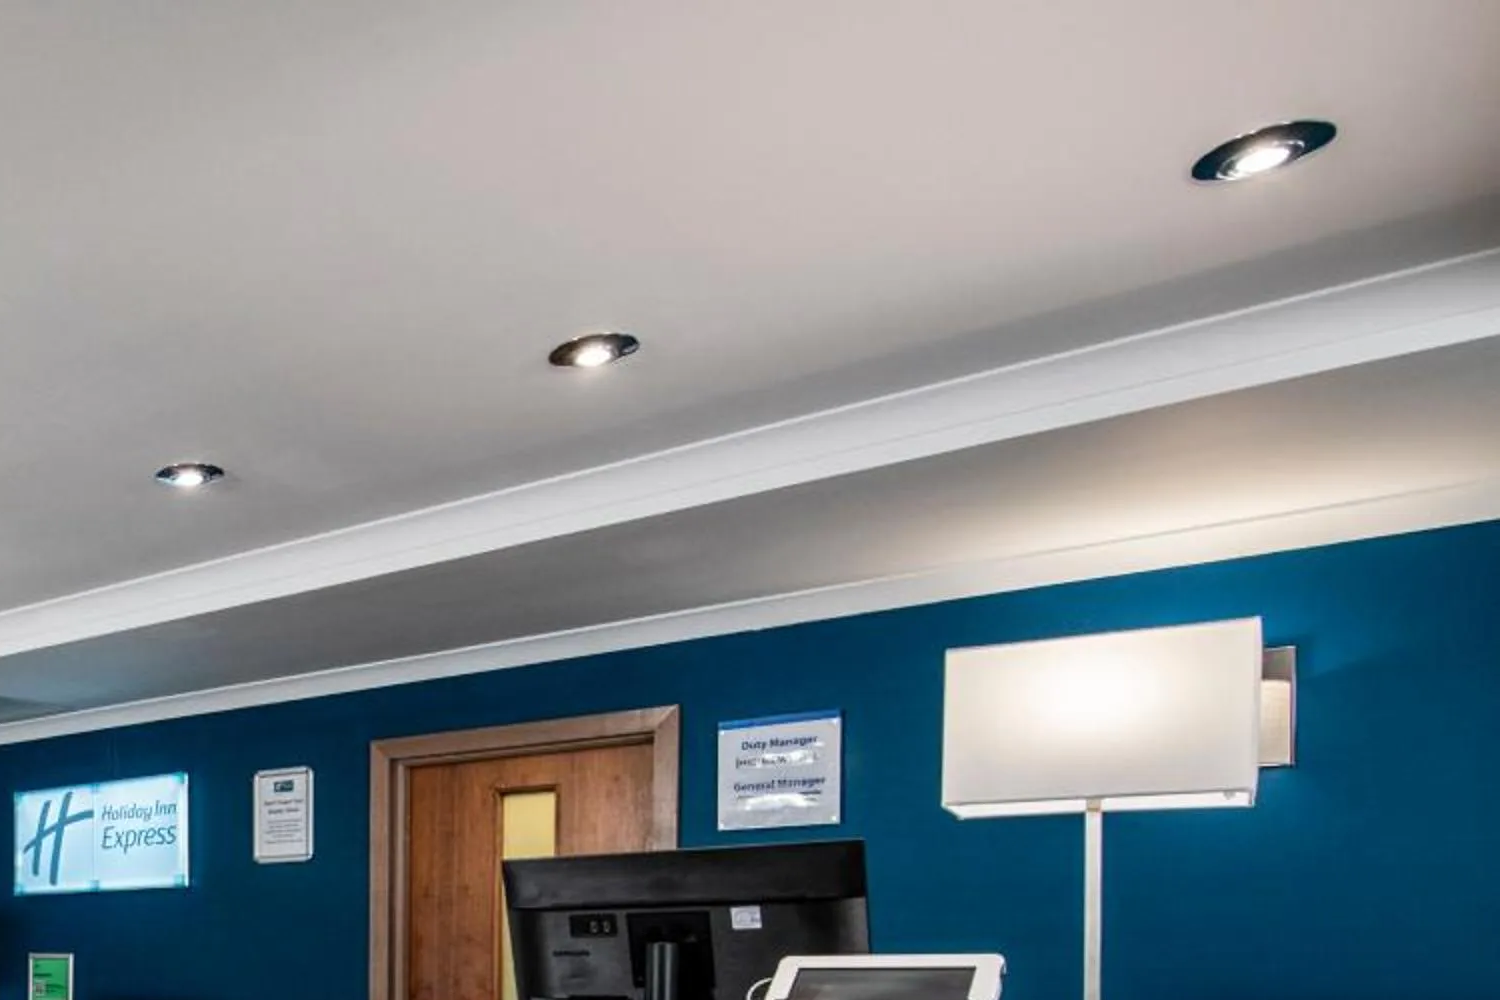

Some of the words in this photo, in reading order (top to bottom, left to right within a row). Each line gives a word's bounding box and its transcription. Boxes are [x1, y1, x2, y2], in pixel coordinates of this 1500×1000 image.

[741, 740, 767, 751] Duty
[769, 736, 818, 748] Manager
[733, 779, 775, 792] General
[777, 776, 825, 789] Manager
[101, 802, 153, 822] Holiday
[154, 799, 177, 817] Inn
[101, 824, 177, 855] Express
